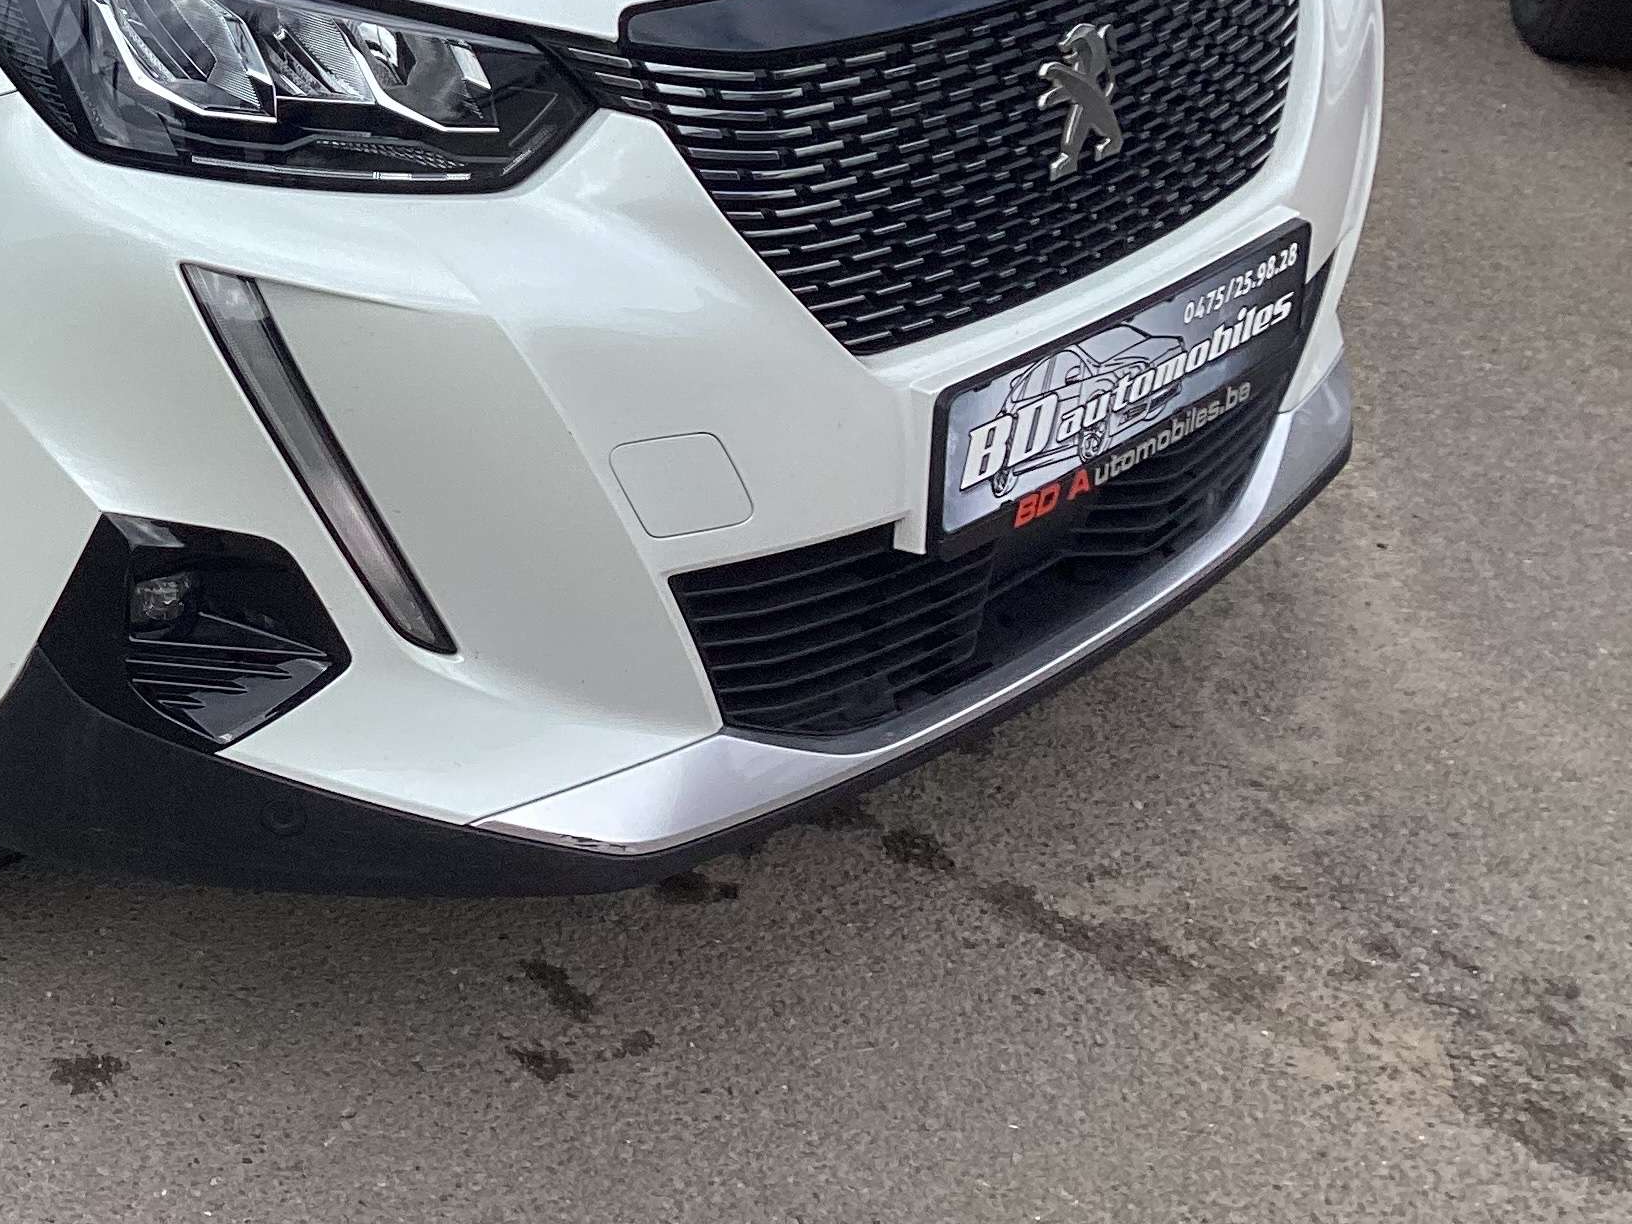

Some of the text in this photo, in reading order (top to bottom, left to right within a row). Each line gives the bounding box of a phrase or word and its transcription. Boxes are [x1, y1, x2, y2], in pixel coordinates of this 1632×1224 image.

[1183, 242, 1298, 324] 0475/25.98.28
[1014, 380, 1251, 528] BD Automobiles.be
